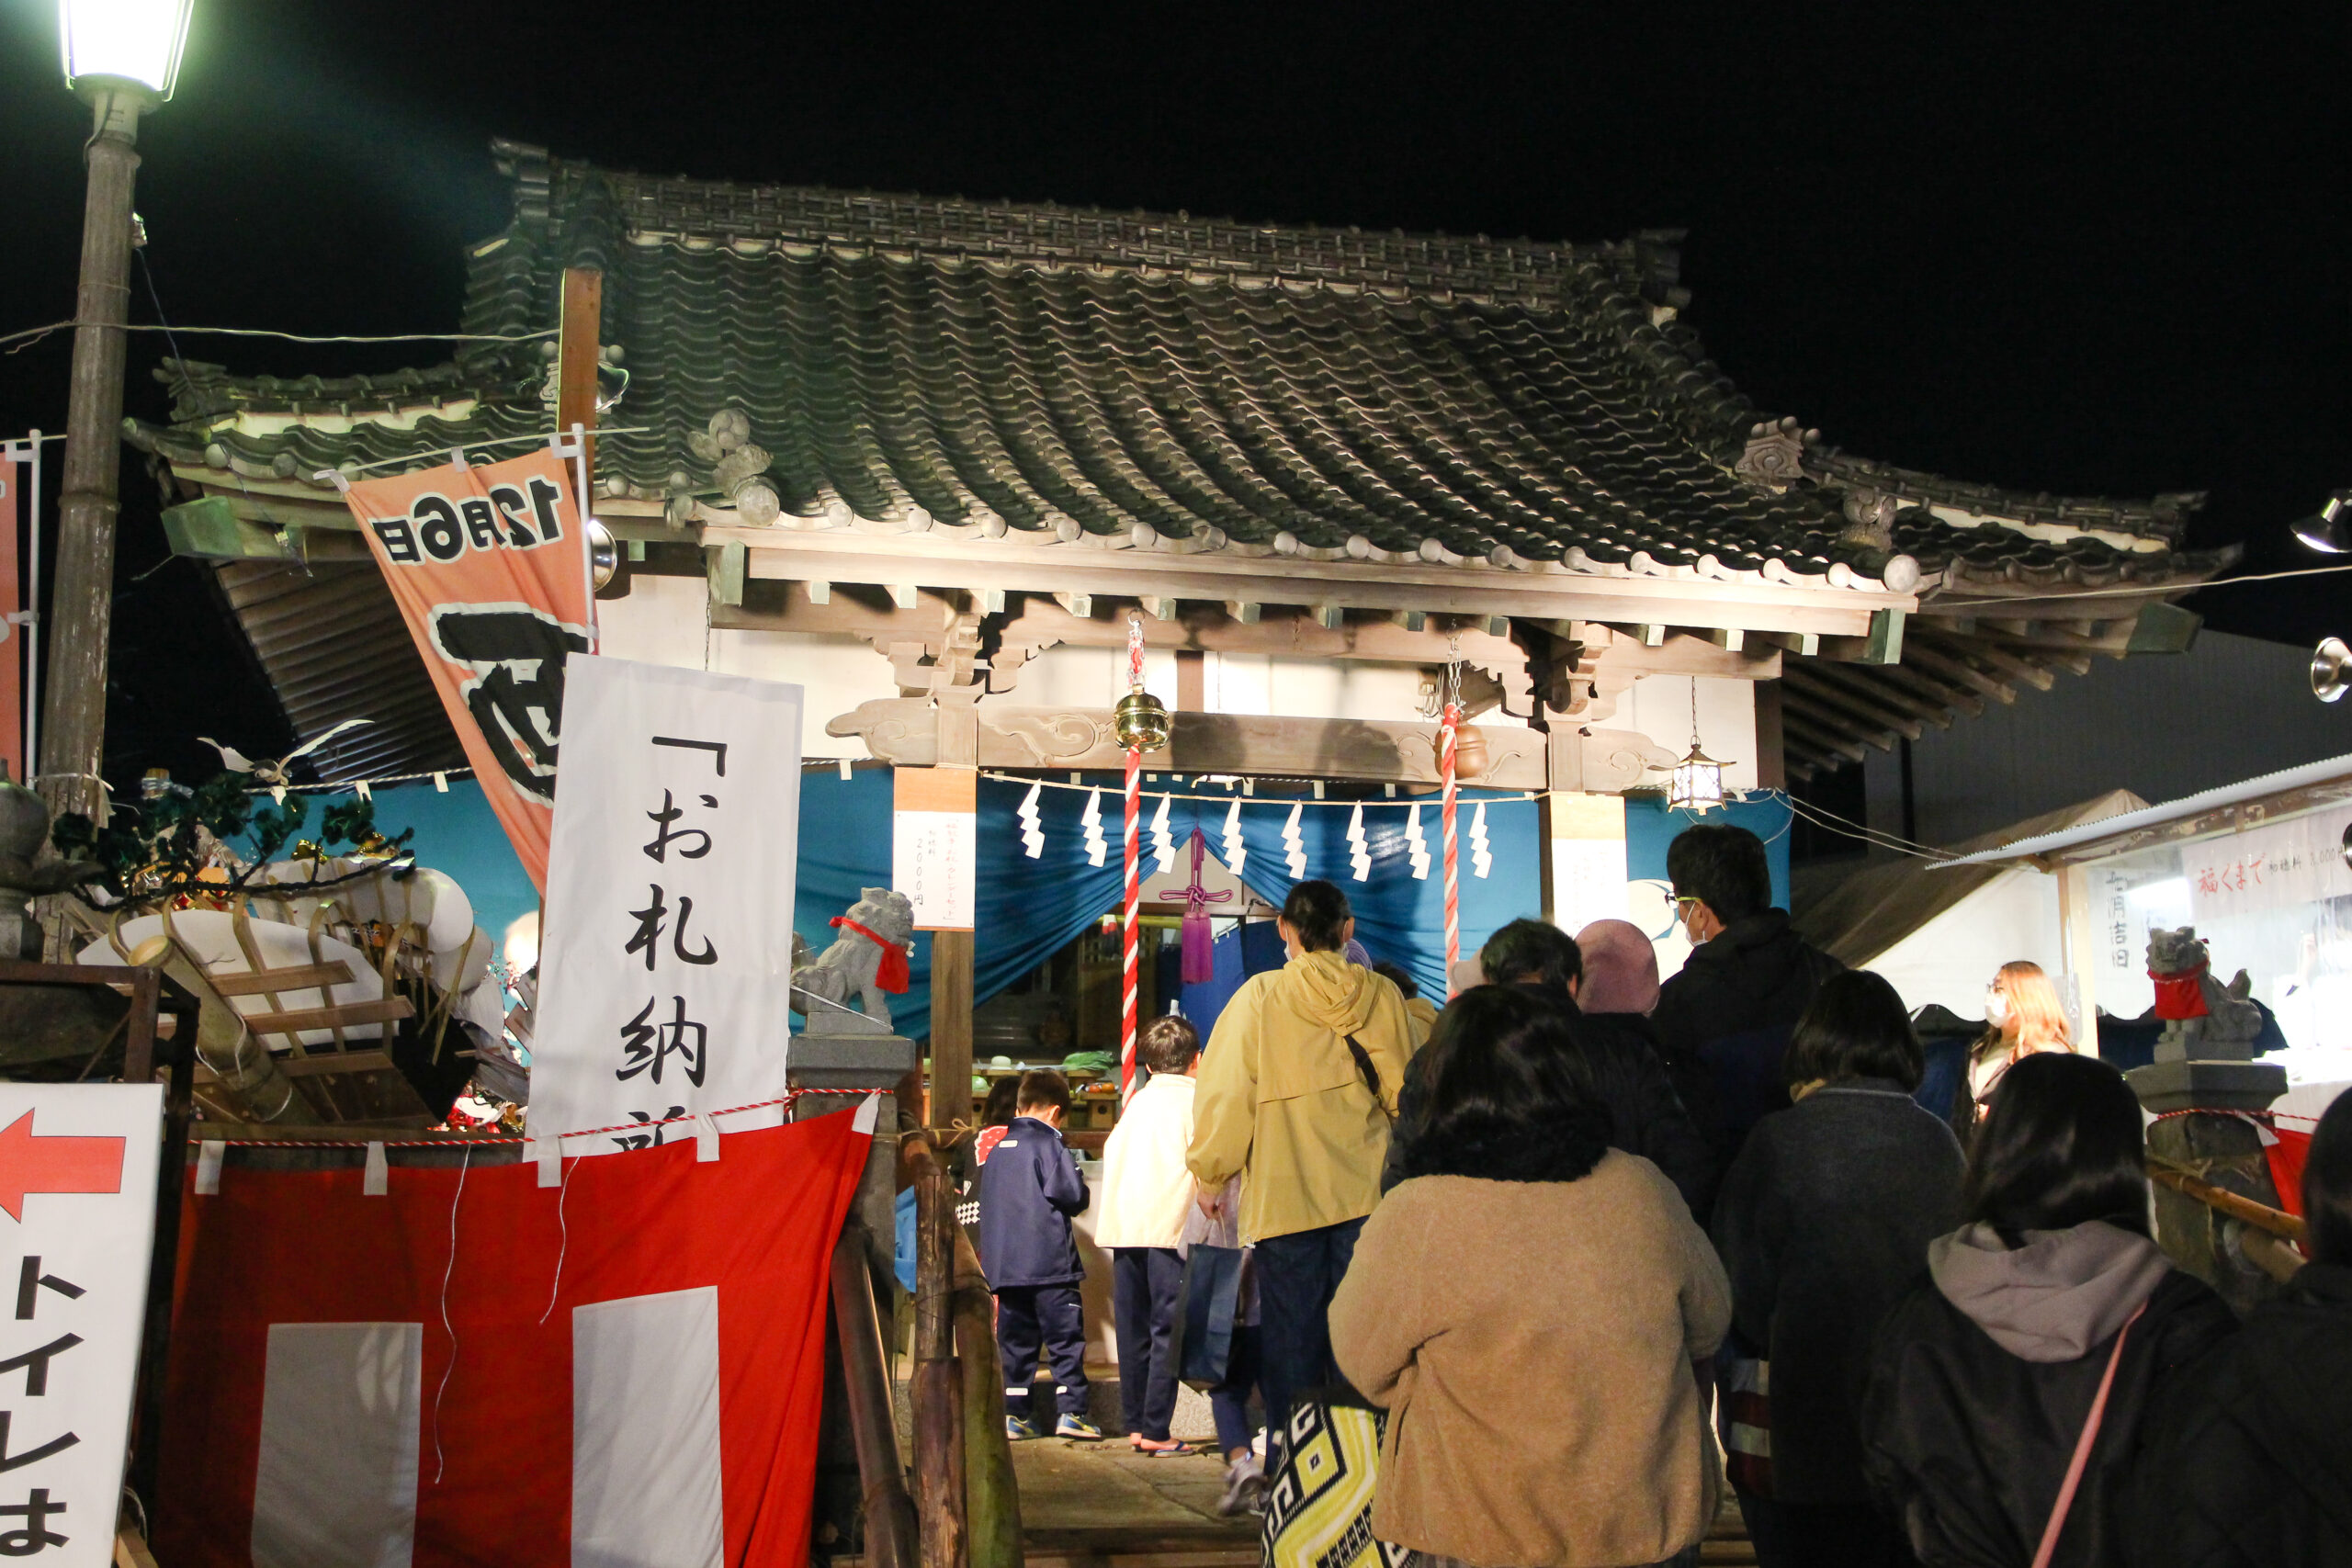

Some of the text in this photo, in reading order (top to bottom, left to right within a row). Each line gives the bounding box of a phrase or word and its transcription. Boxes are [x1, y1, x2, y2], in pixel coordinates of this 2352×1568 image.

[913, 838, 923, 906] 2000円
[2198, 852, 2266, 897] 福くまで
[0, 1255, 87, 1557] トイレは
